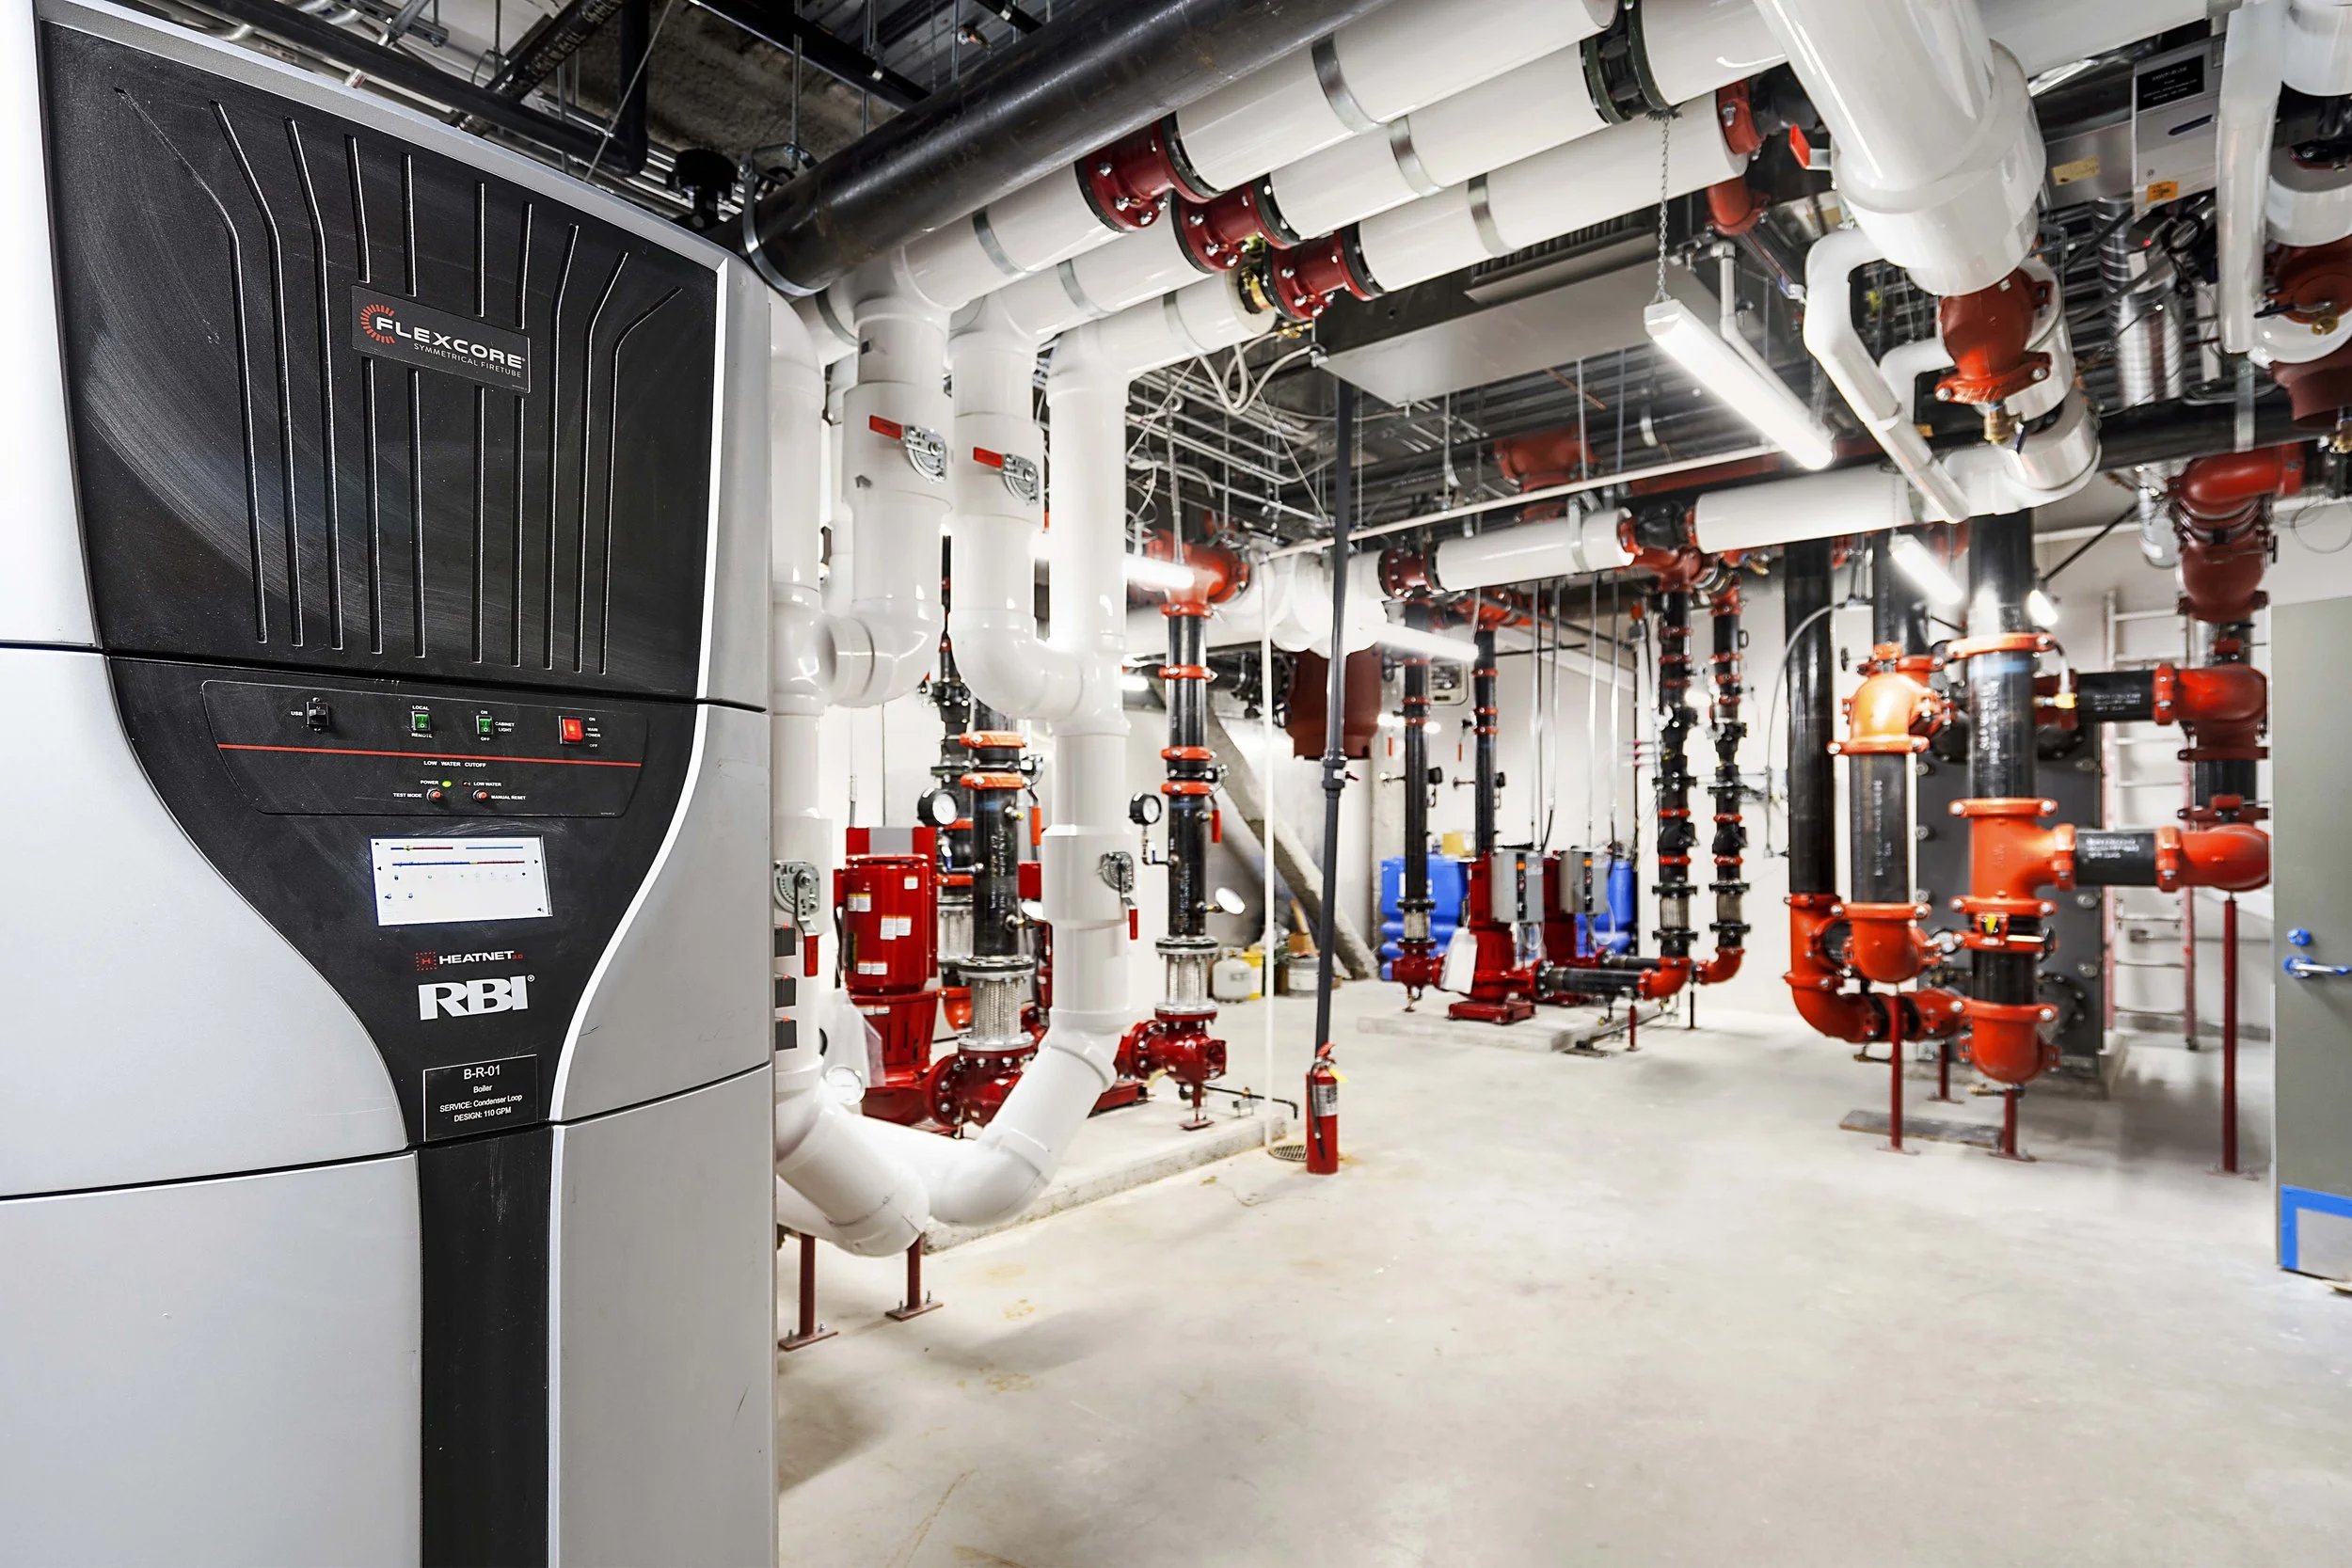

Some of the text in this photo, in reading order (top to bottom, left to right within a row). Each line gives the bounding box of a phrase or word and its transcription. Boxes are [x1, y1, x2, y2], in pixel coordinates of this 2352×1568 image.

[376, 316, 522, 369] FLEXCORE
[413, 342, 522, 378] SYMMETRICAL FIRETUBE
[438, 950, 516, 965] HEATNET
[463, 1065, 501, 1080] B-R-01
[473, 1085, 493, 1094] Boiler
[439, 1094, 523, 1113] SERVICE: Condenser Loop
[453, 1106, 512, 1123] DESIGN: 110 GPM
